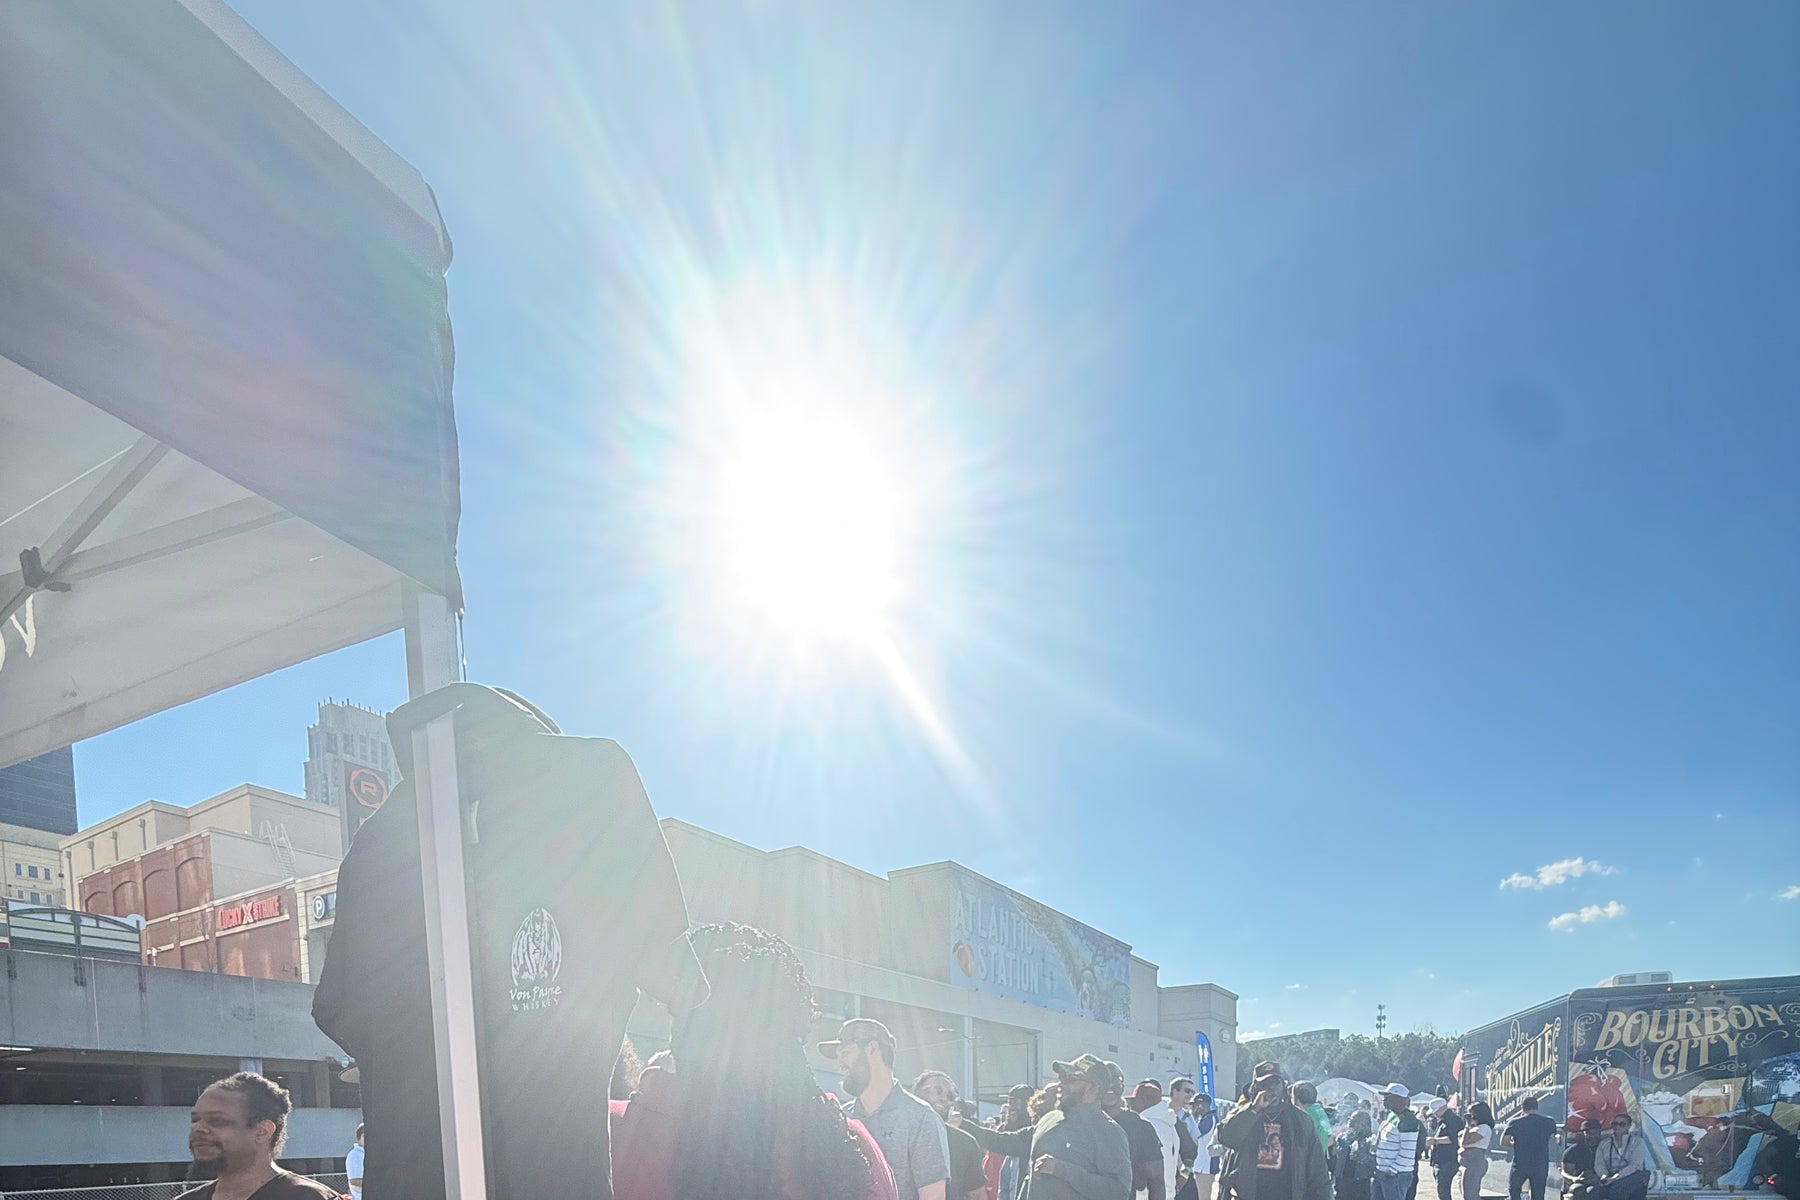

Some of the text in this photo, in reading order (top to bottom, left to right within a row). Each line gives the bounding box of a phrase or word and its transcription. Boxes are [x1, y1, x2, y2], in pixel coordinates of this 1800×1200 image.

[219, 907, 242, 929] LUCKY
[253, 895, 280, 921] STRIKE
[953, 889, 1034, 956] ATLANTIC
[977, 941, 1040, 994] STATION
[509, 988, 532, 1001] Von
[511, 998, 561, 1012] WHISKEY
[1592, 1003, 1786, 1051] BOURBON
[1485, 1028, 1553, 1120] LOUISVILLE
[1652, 1031, 1742, 1080] CITY
